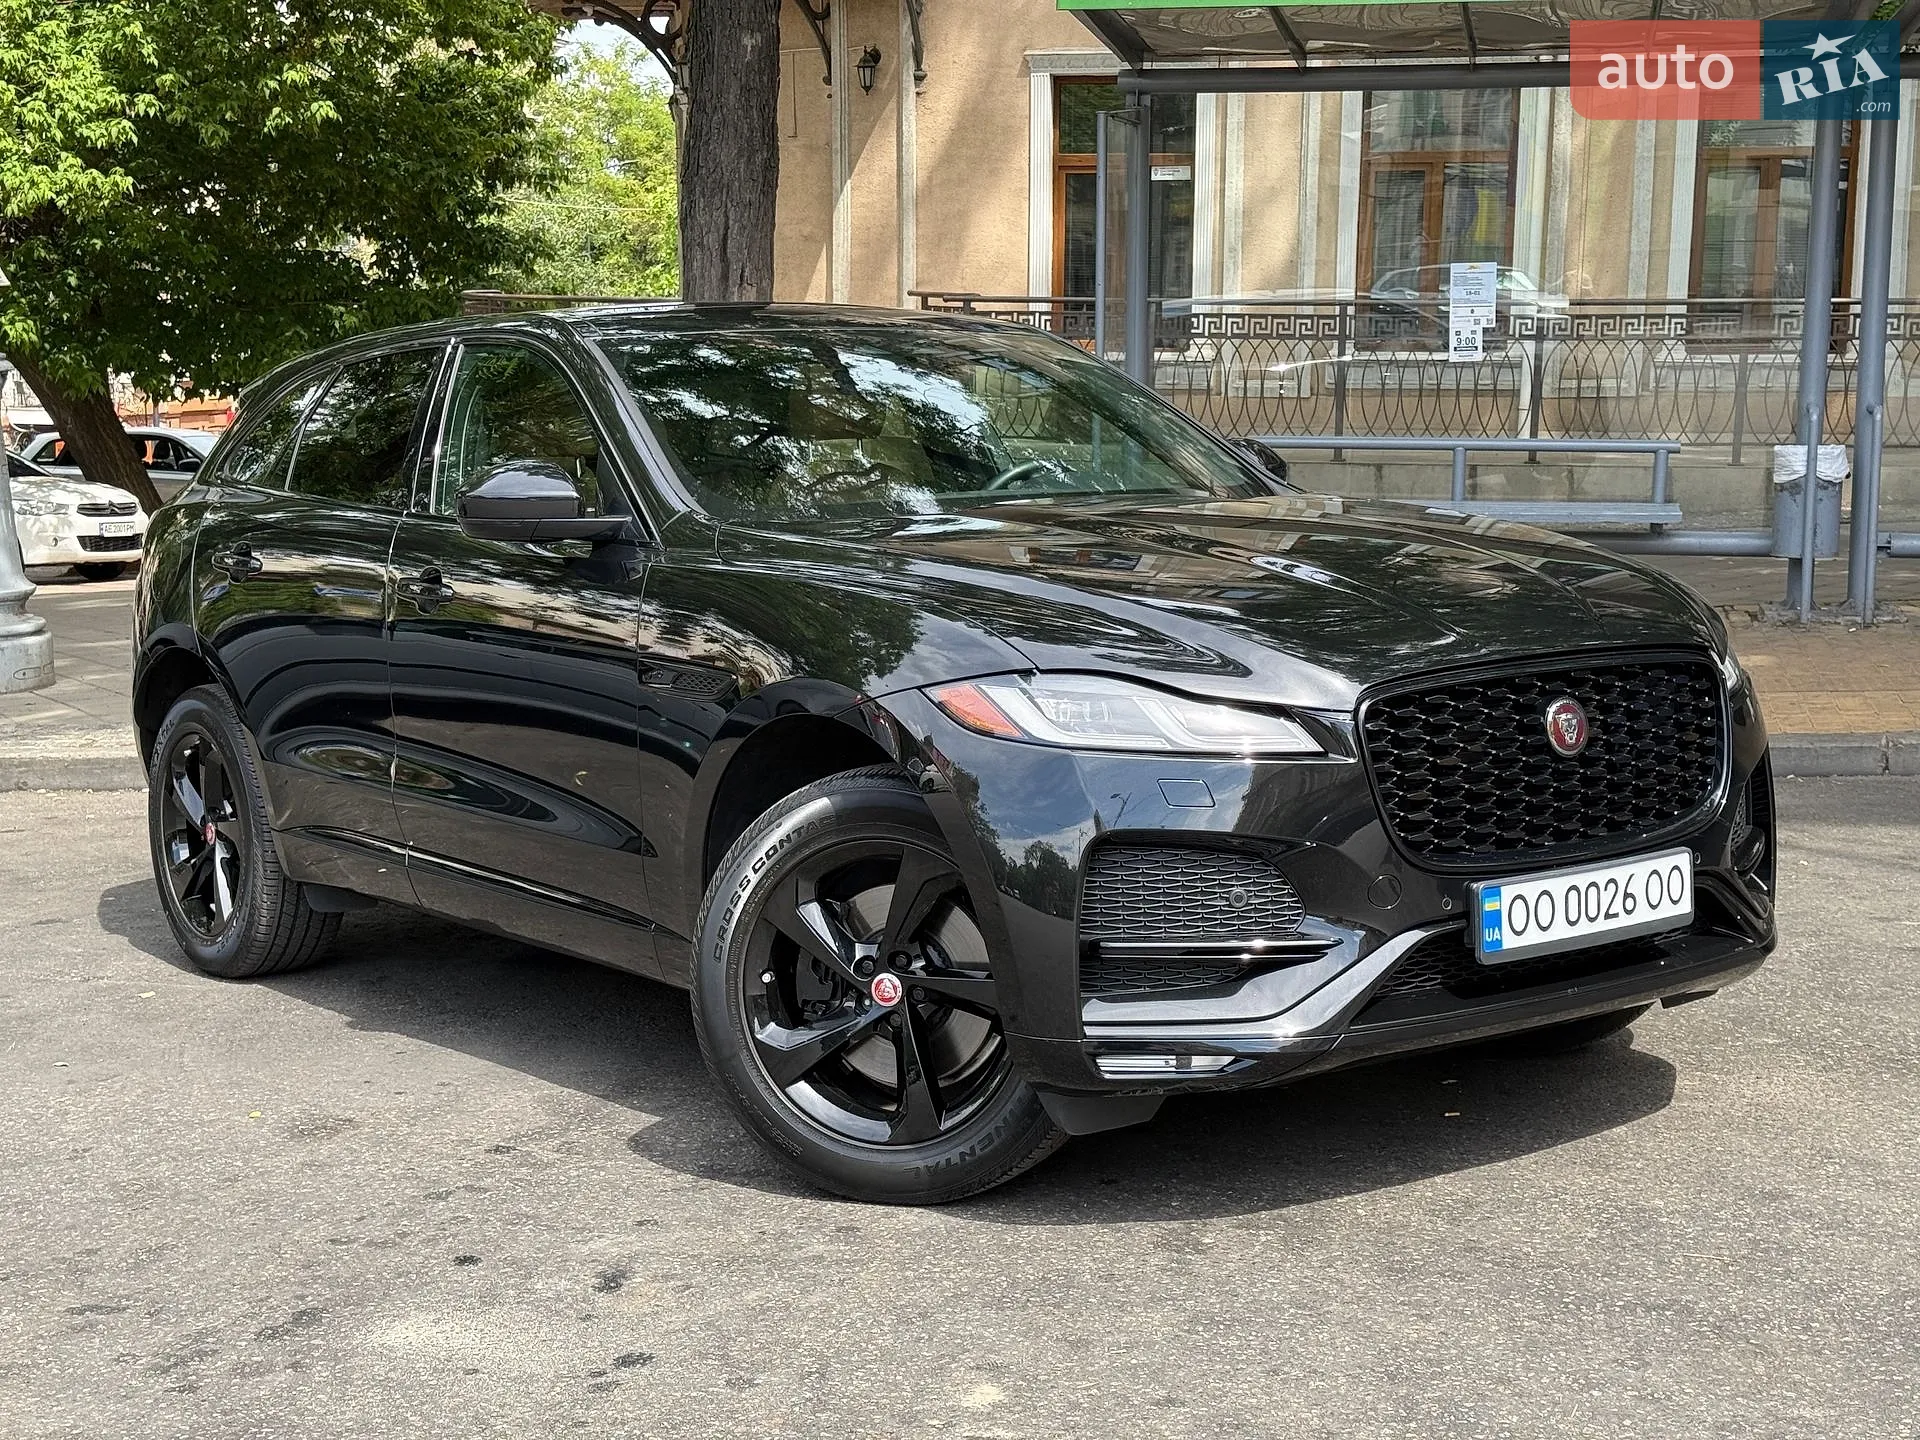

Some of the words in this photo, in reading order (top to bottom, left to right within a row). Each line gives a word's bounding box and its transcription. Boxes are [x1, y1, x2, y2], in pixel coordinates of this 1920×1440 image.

[1456, 337, 1476, 346] 9:00
[713, 875, 752, 965] CROSS
[752, 815, 843, 876] CONTA
[1508, 889, 1556, 937] OO
[1564, 873, 1637, 927] 0026
[1645, 864, 1685, 910] OO
[1485, 927, 1501, 942] UA
